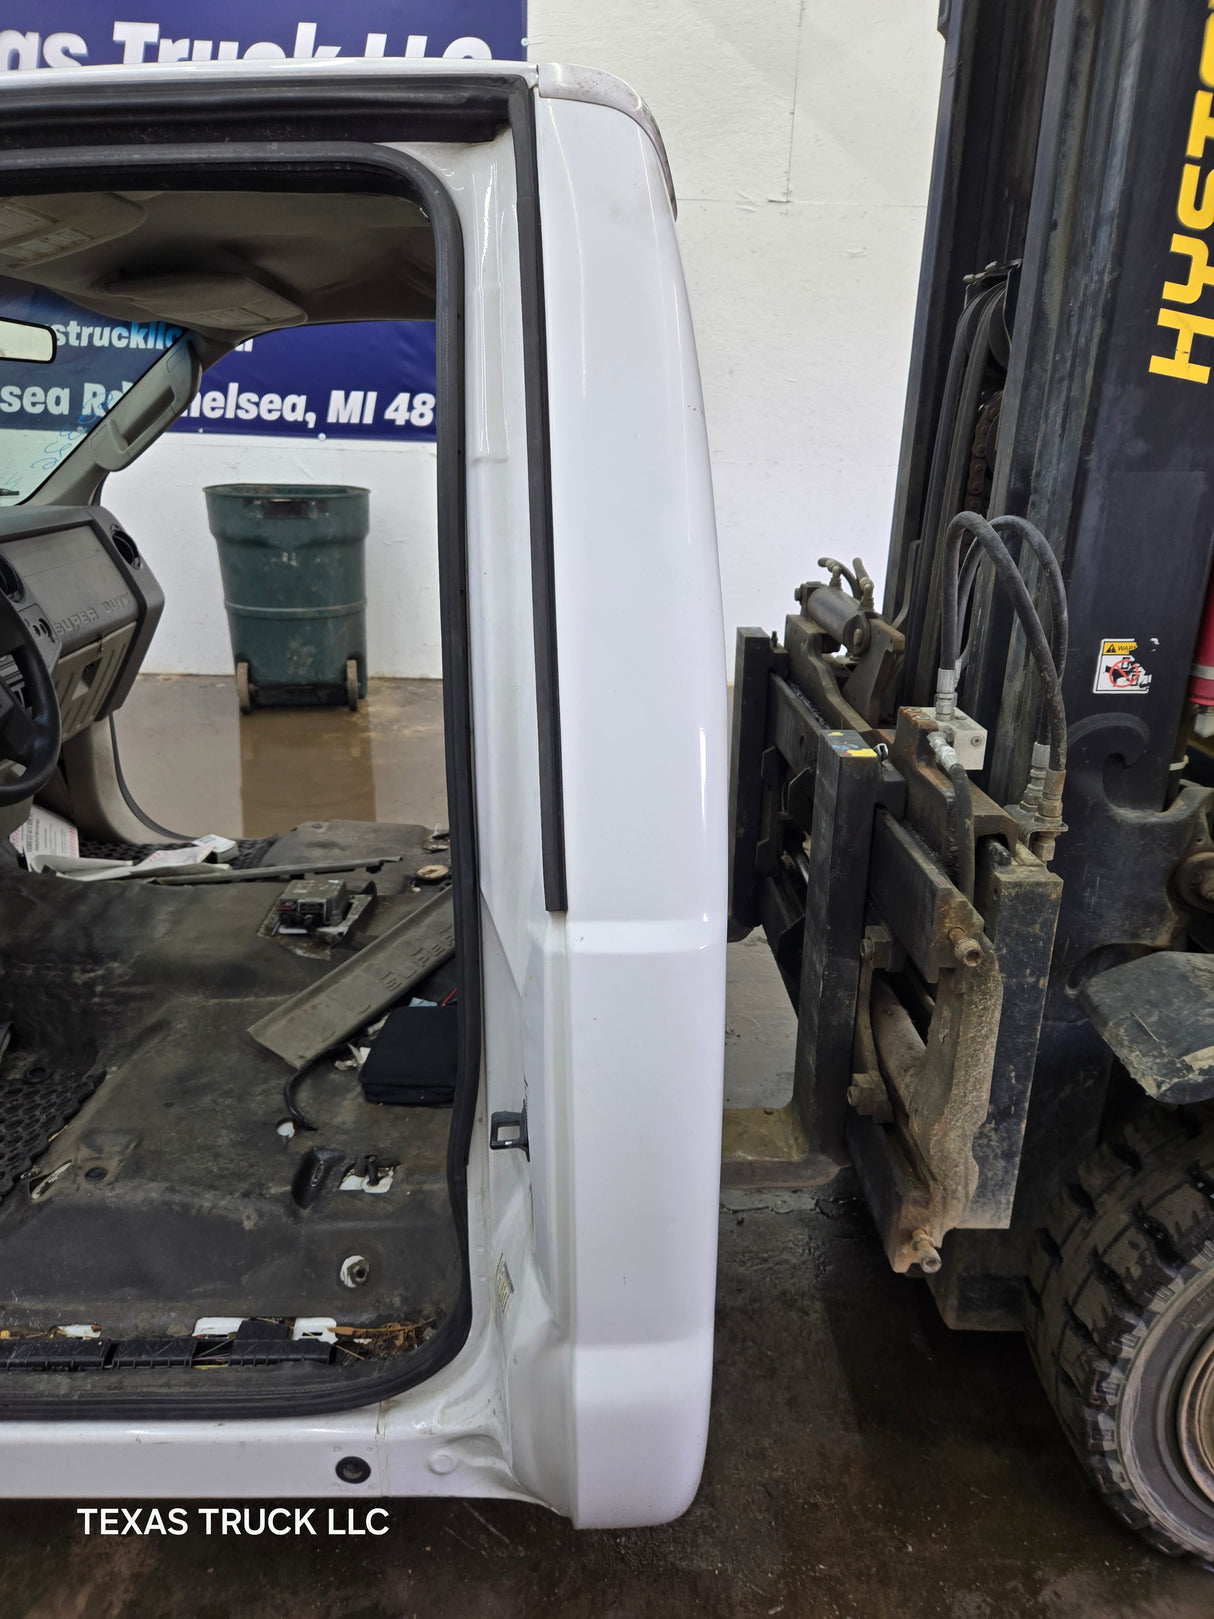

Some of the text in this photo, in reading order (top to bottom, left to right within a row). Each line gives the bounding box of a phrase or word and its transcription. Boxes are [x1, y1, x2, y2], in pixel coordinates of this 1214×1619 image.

[327, 390, 378, 425] MI
[384, 392, 436, 427] 48
[54, 592, 131, 636] SUPER DUTY
